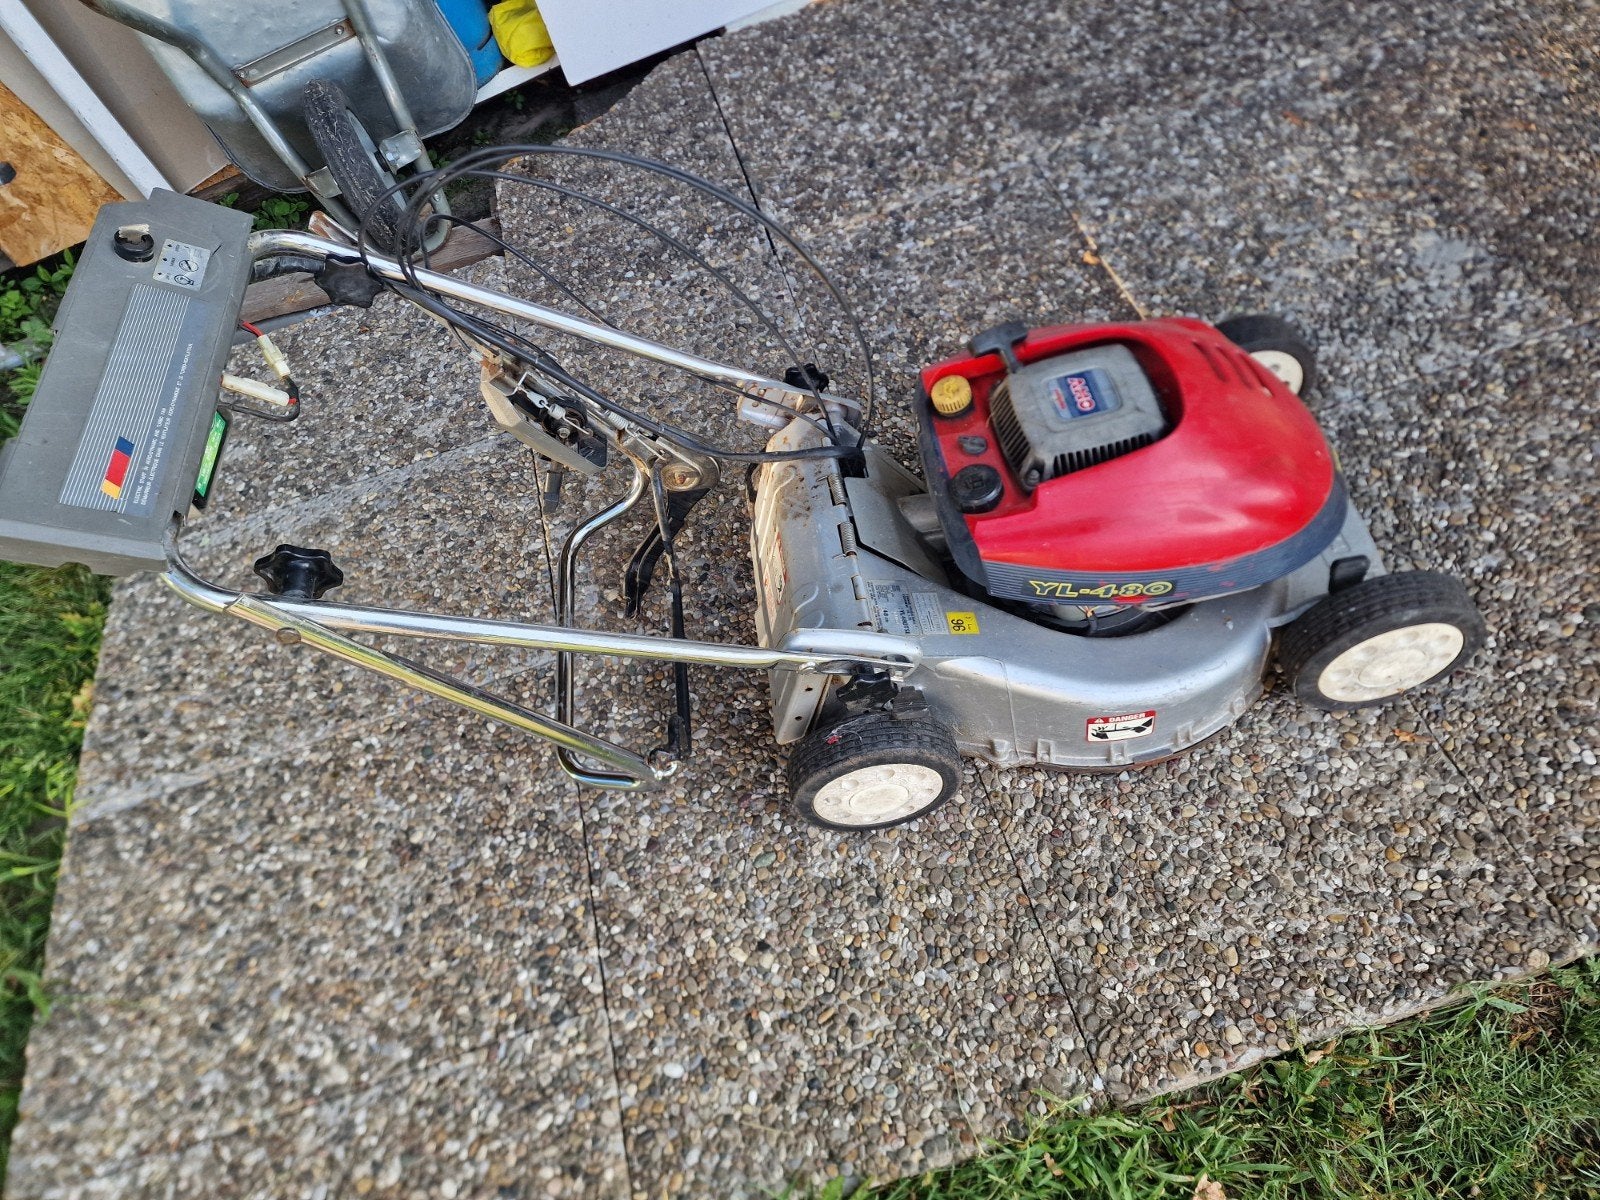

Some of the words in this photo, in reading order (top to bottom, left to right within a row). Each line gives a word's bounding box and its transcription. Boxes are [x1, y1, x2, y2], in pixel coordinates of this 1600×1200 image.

[1029, 580, 1173, 598] YL-480
[951, 619, 965, 631] 96
[1109, 713, 1145, 722] DANGER
